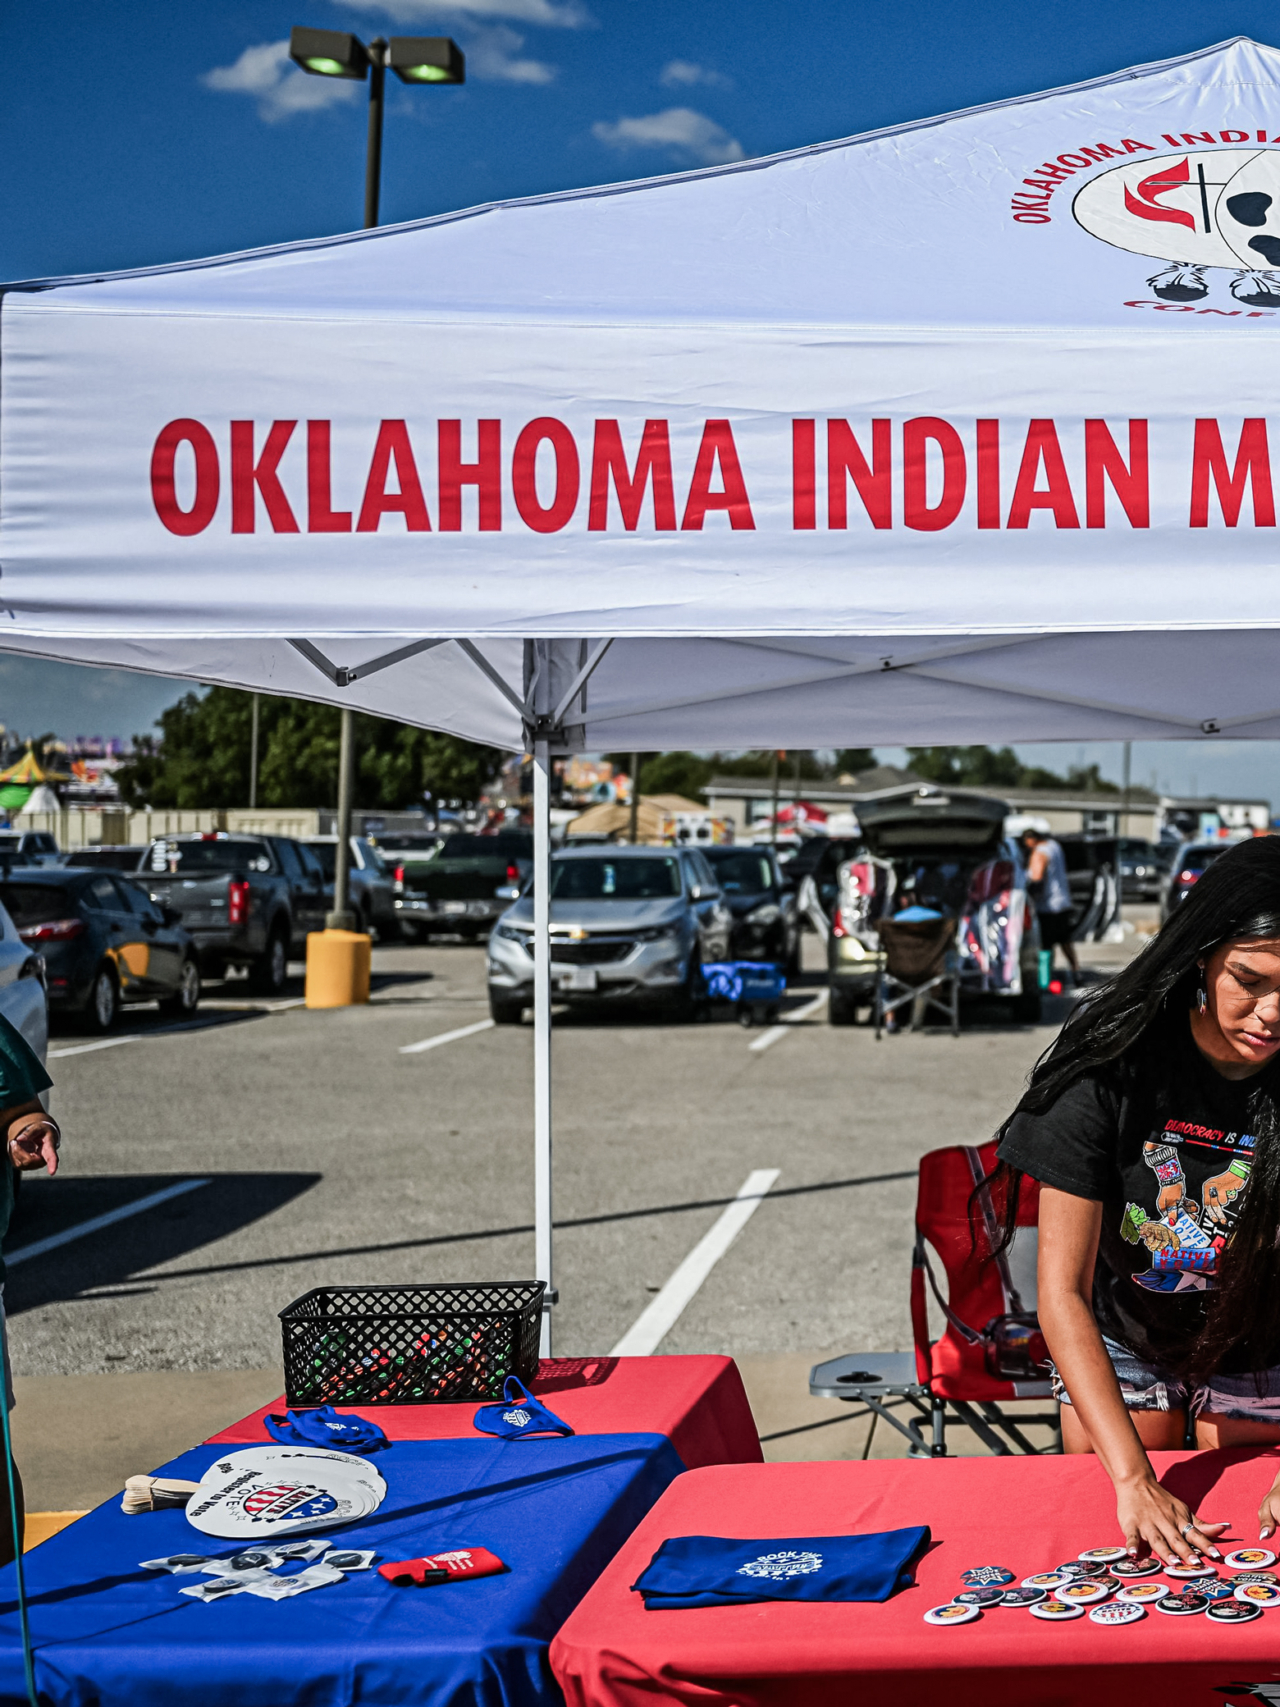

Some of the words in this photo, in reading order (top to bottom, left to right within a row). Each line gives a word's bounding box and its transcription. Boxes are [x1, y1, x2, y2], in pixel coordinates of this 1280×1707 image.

[1012, 143, 1157, 224] OKLAHOMA
[150, 416, 755, 536] OKLAHOMA
[793, 417, 1151, 531] INDIAN
[1164, 1119, 1225, 1141] DEMOCRACY
[1224, 1131, 1237, 1144] IS
[1160, 1249, 1212, 1260] NATIVE
[220, 1471, 263, 1494] Register
[210, 1493, 227, 1501] to
[226, 1484, 264, 1506] VOTE
[189, 1501, 219, 1517] Vote
